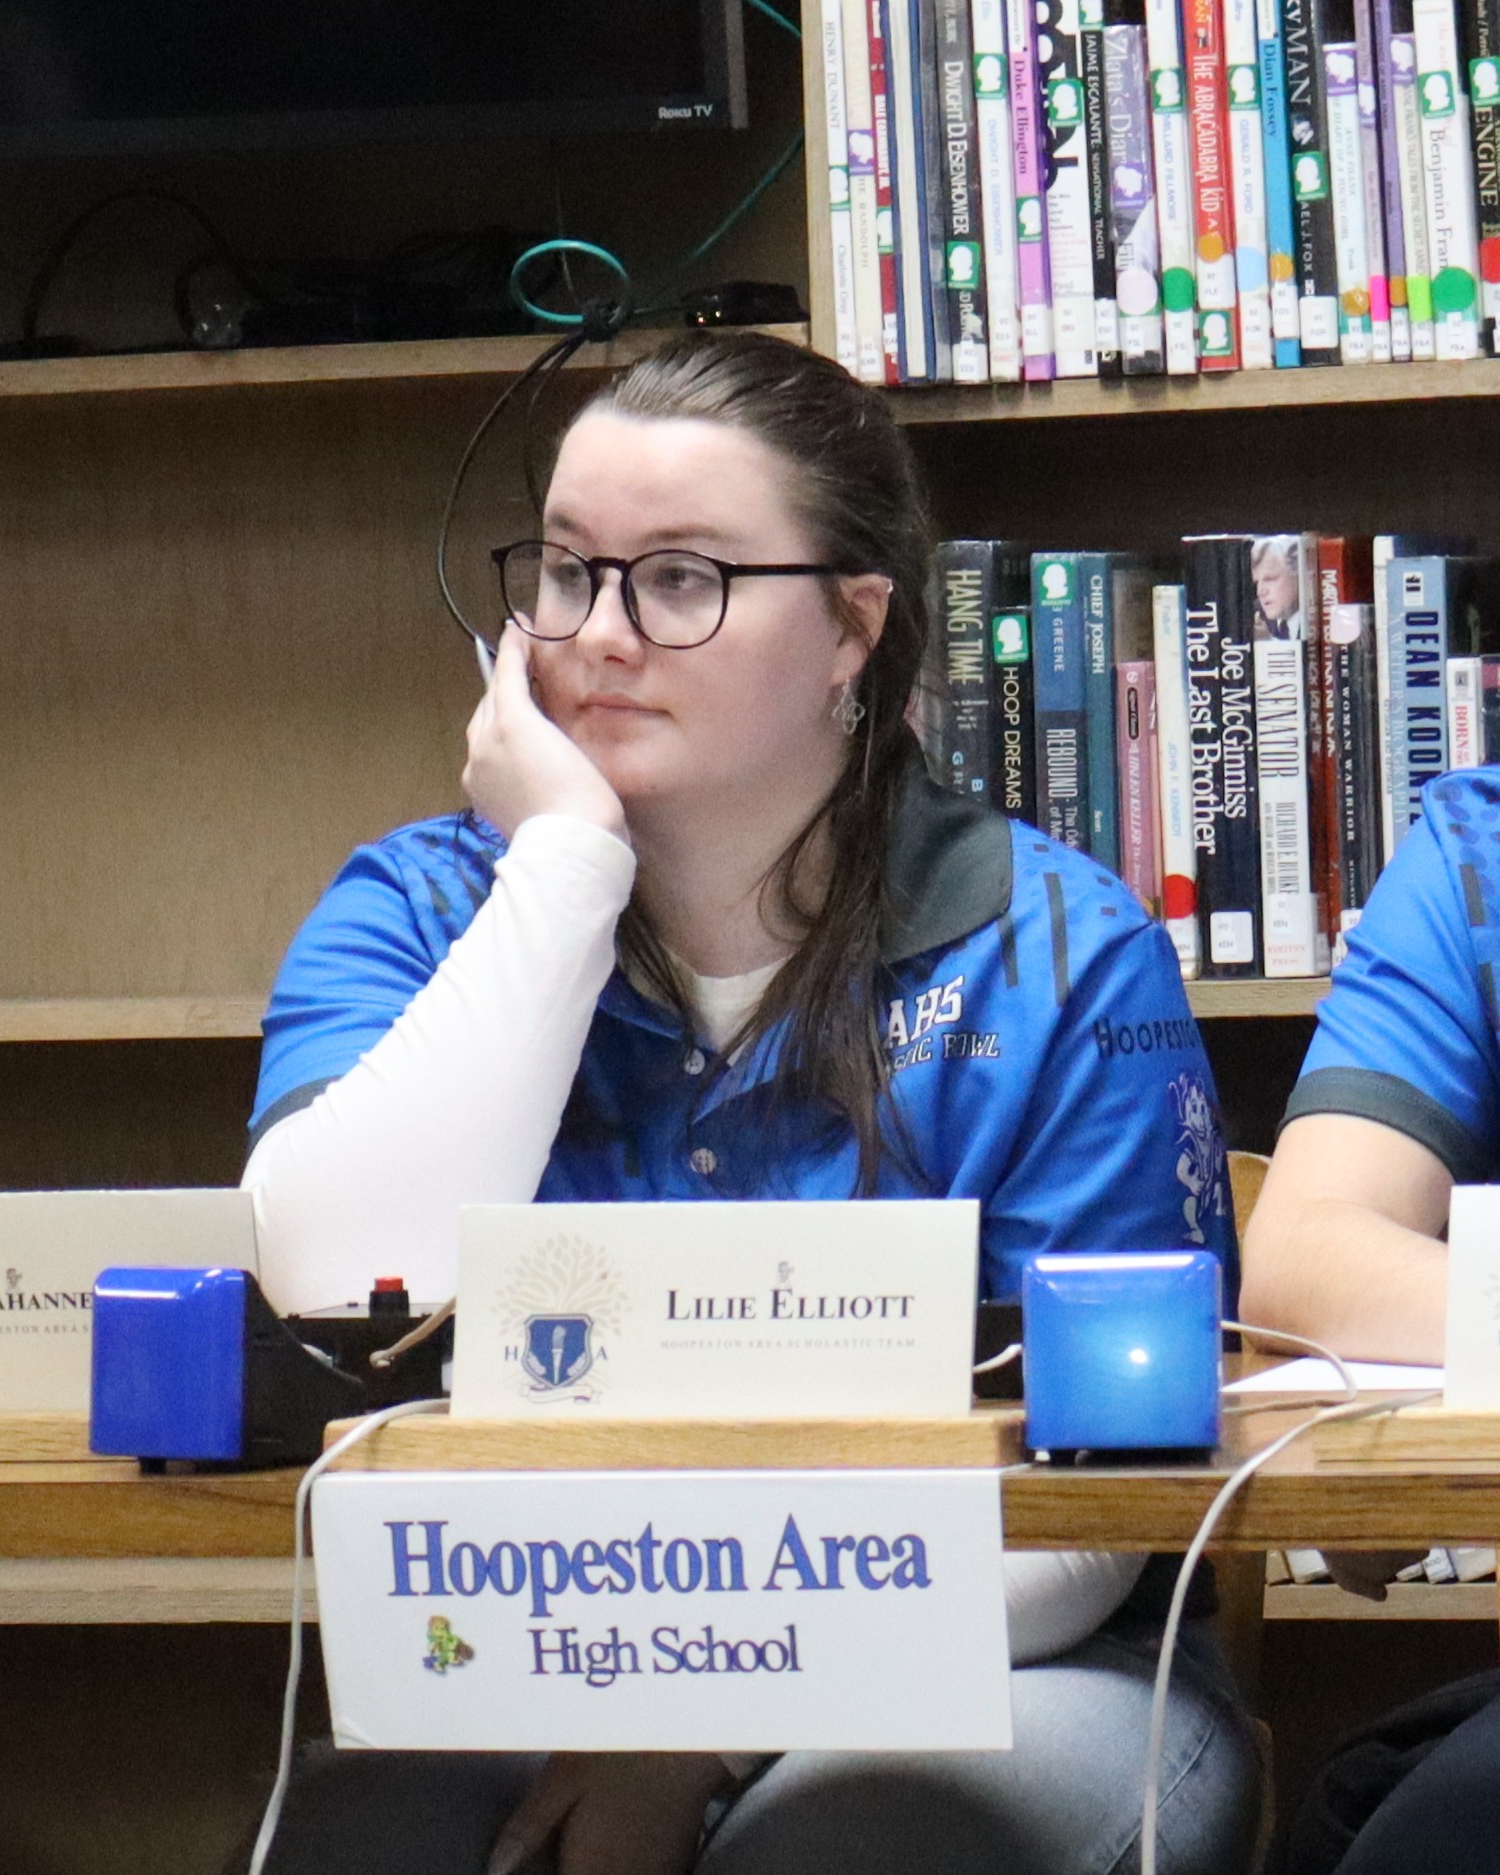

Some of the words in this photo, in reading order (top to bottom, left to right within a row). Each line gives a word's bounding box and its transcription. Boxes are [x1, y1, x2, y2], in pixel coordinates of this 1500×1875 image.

[944, 60, 966, 120] DWIGHT
[1013, 60, 1026, 100] Duke
[1193, 55, 1217, 84] THE
[1262, 43, 1276, 82] Dian
[659, 107, 692, 119] Roku
[694, 105, 713, 117] TV
[1194, 87, 1220, 182] ABRACADABRA
[1016, 106, 1030, 175] Ellington
[1474, 106, 1498, 207] ENGINE
[950, 140, 970, 235] EISENHOWER
[1200, 188, 1222, 212] KID
[1429, 129, 1450, 218] Benjamin
[1302, 243, 1315, 272] FOX
[946, 568, 984, 632] HANG
[1090, 574, 1103, 618] CHIEF
[1091, 622, 1104, 674] JOSEPH
[1185, 601, 1217, 662] The
[1219, 637, 1249, 680] Joe
[1405, 611, 1441, 688] DEAN
[949, 639, 985, 685] TIME
[1267, 650, 1296, 679] THE
[1002, 666, 1019, 726] HOOP
[1188, 667, 1220, 738] Last
[1341, 688, 1352, 751] WOMAN
[1167, 741, 1179, 769] JOHN
[1221, 688, 1254, 818] McGinniss
[1256, 683, 1300, 779] SENATOR
[1454, 705, 1469, 749] BORN
[1004, 731, 1022, 808] DREAMS
[1065, 806, 1078, 826] The
[1169, 788, 1182, 837] KENNEDY
[1190, 743, 1222, 855] Brother
[1276, 801, 1297, 849] RICHARD
[1342, 758, 1356, 842] WARRIOR
[44, 1323, 79, 1335] AREA
[665, 1289, 758, 1321] LILIE
[768, 1287, 916, 1321] ELLIOTT
[503, 1345, 520, 1362] H
[595, 1346, 609, 1361] A
[382, 1519, 750, 1620] Hoopeston
[761, 1511, 933, 1593] Area
[528, 1627, 644, 1690] High
[650, 1623, 803, 1675] School
